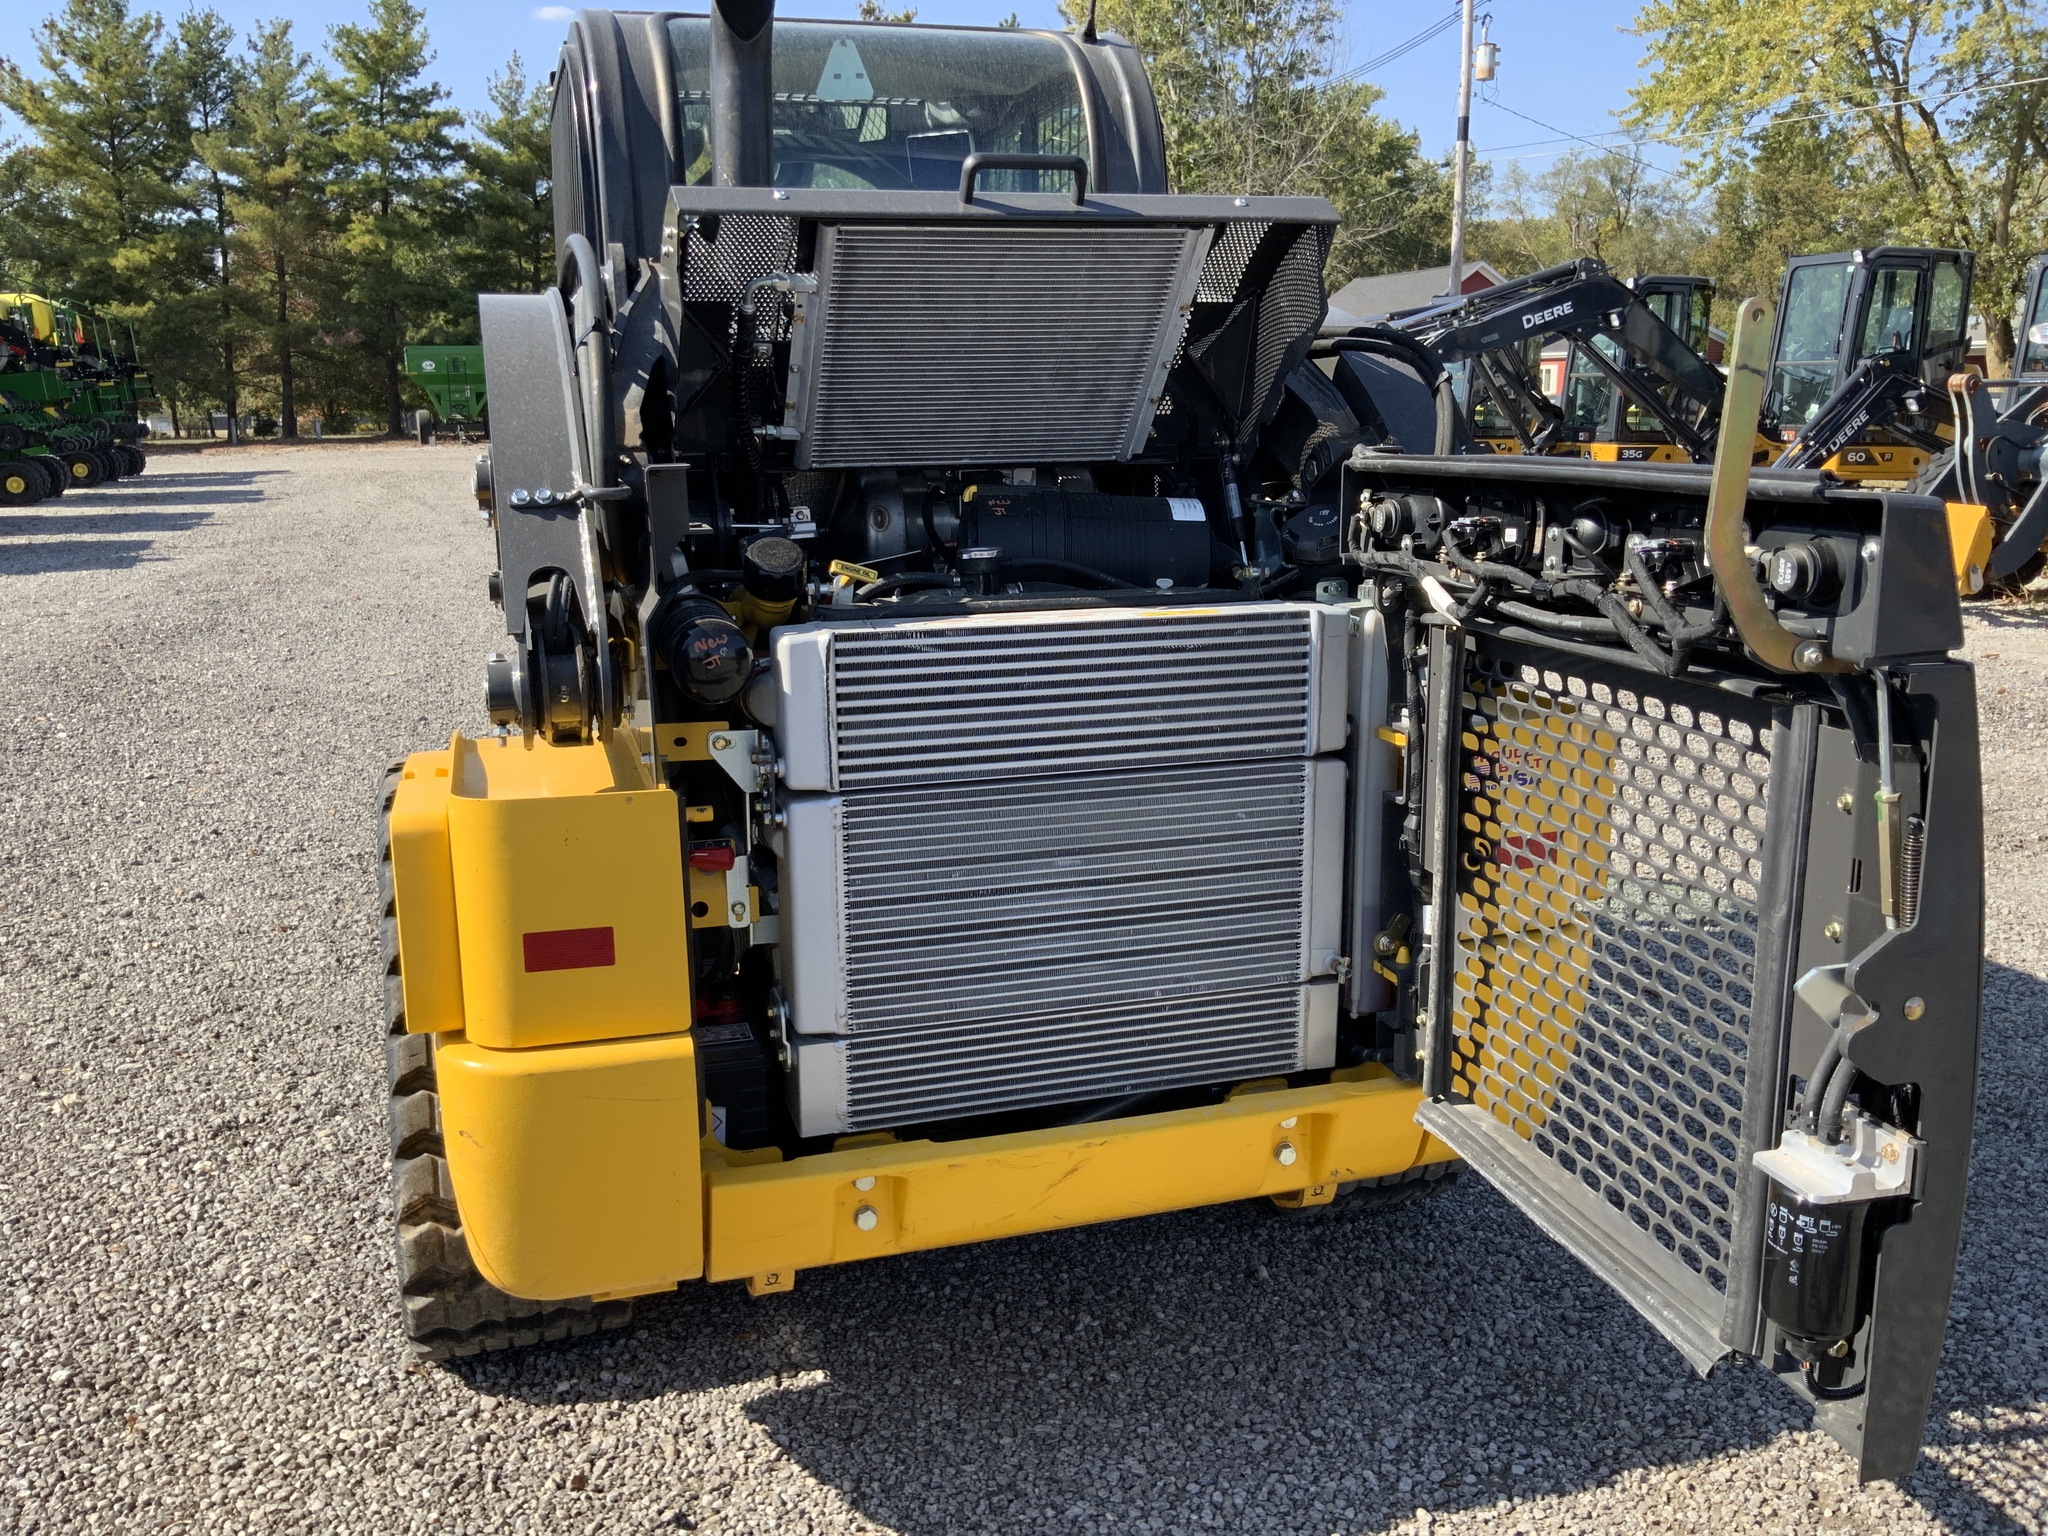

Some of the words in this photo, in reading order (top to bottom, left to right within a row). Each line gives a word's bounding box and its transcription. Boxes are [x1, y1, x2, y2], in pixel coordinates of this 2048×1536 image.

[1521, 301, 1574, 330] DEERE
[1829, 409, 1870, 452] DEERE
[1621, 449, 1643, 459] 35G
[1847, 452, 1866, 462] 60
[841, 564, 860, 575] ENGINE
[862, 570, 870, 578] OIL
